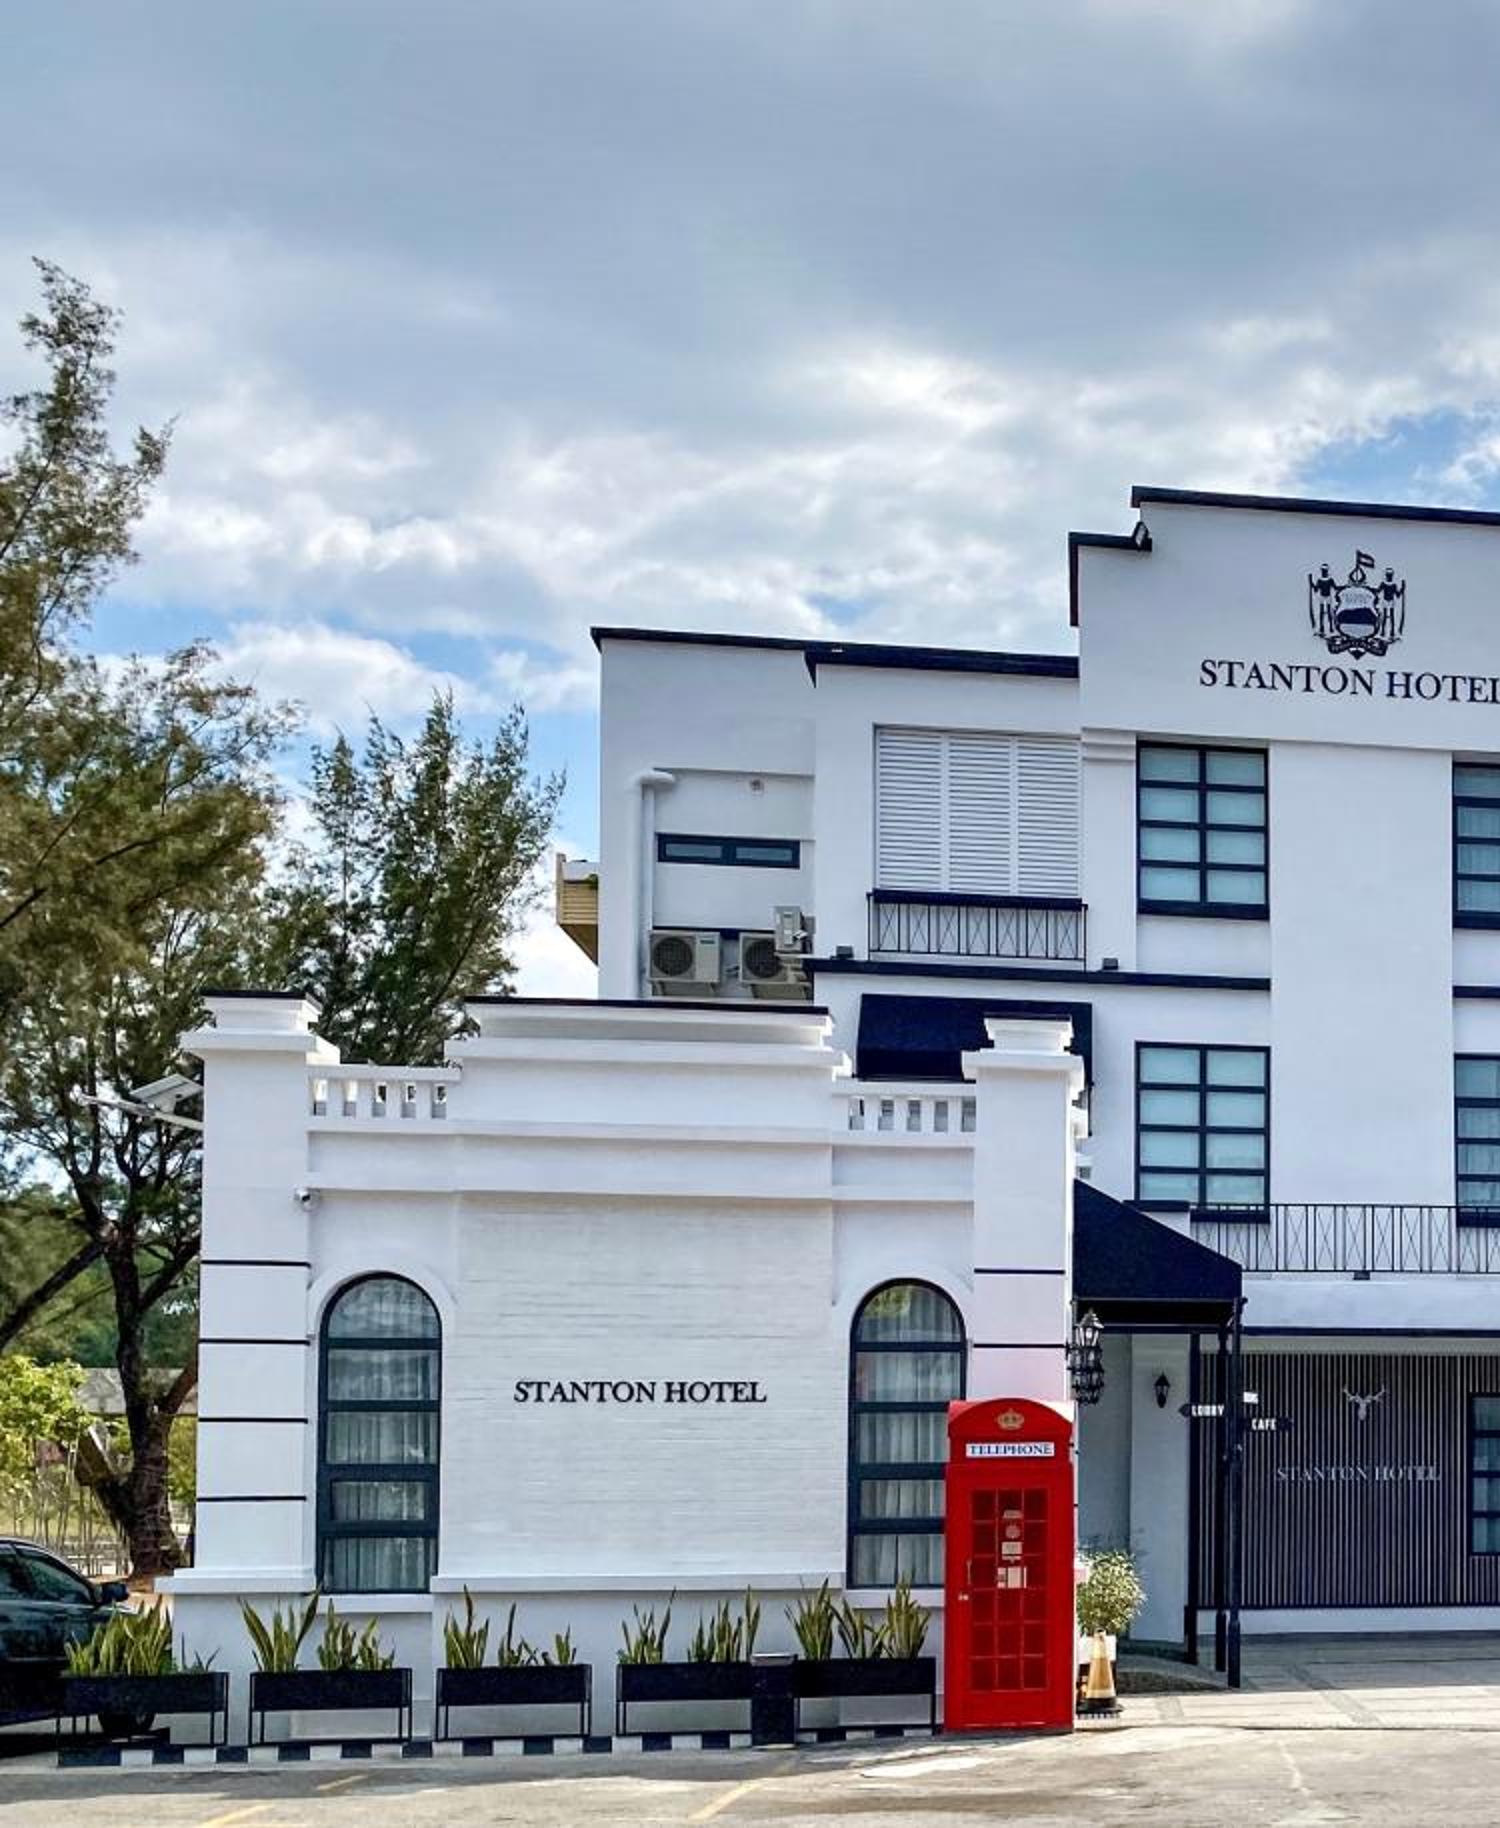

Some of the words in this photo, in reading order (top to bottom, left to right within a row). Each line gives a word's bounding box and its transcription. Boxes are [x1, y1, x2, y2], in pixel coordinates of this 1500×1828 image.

[1200, 658, 1377, 697] STANTON
[513, 1381, 657, 1404] STANTON
[664, 1381, 768, 1403] HOTEL
[1251, 1418, 1277, 1431] CAFE
[971, 1443, 1052, 1455] TELEPHONE
[1277, 1465, 1368, 1482] STANTON
[1374, 1465, 1441, 1482] HOTEL
